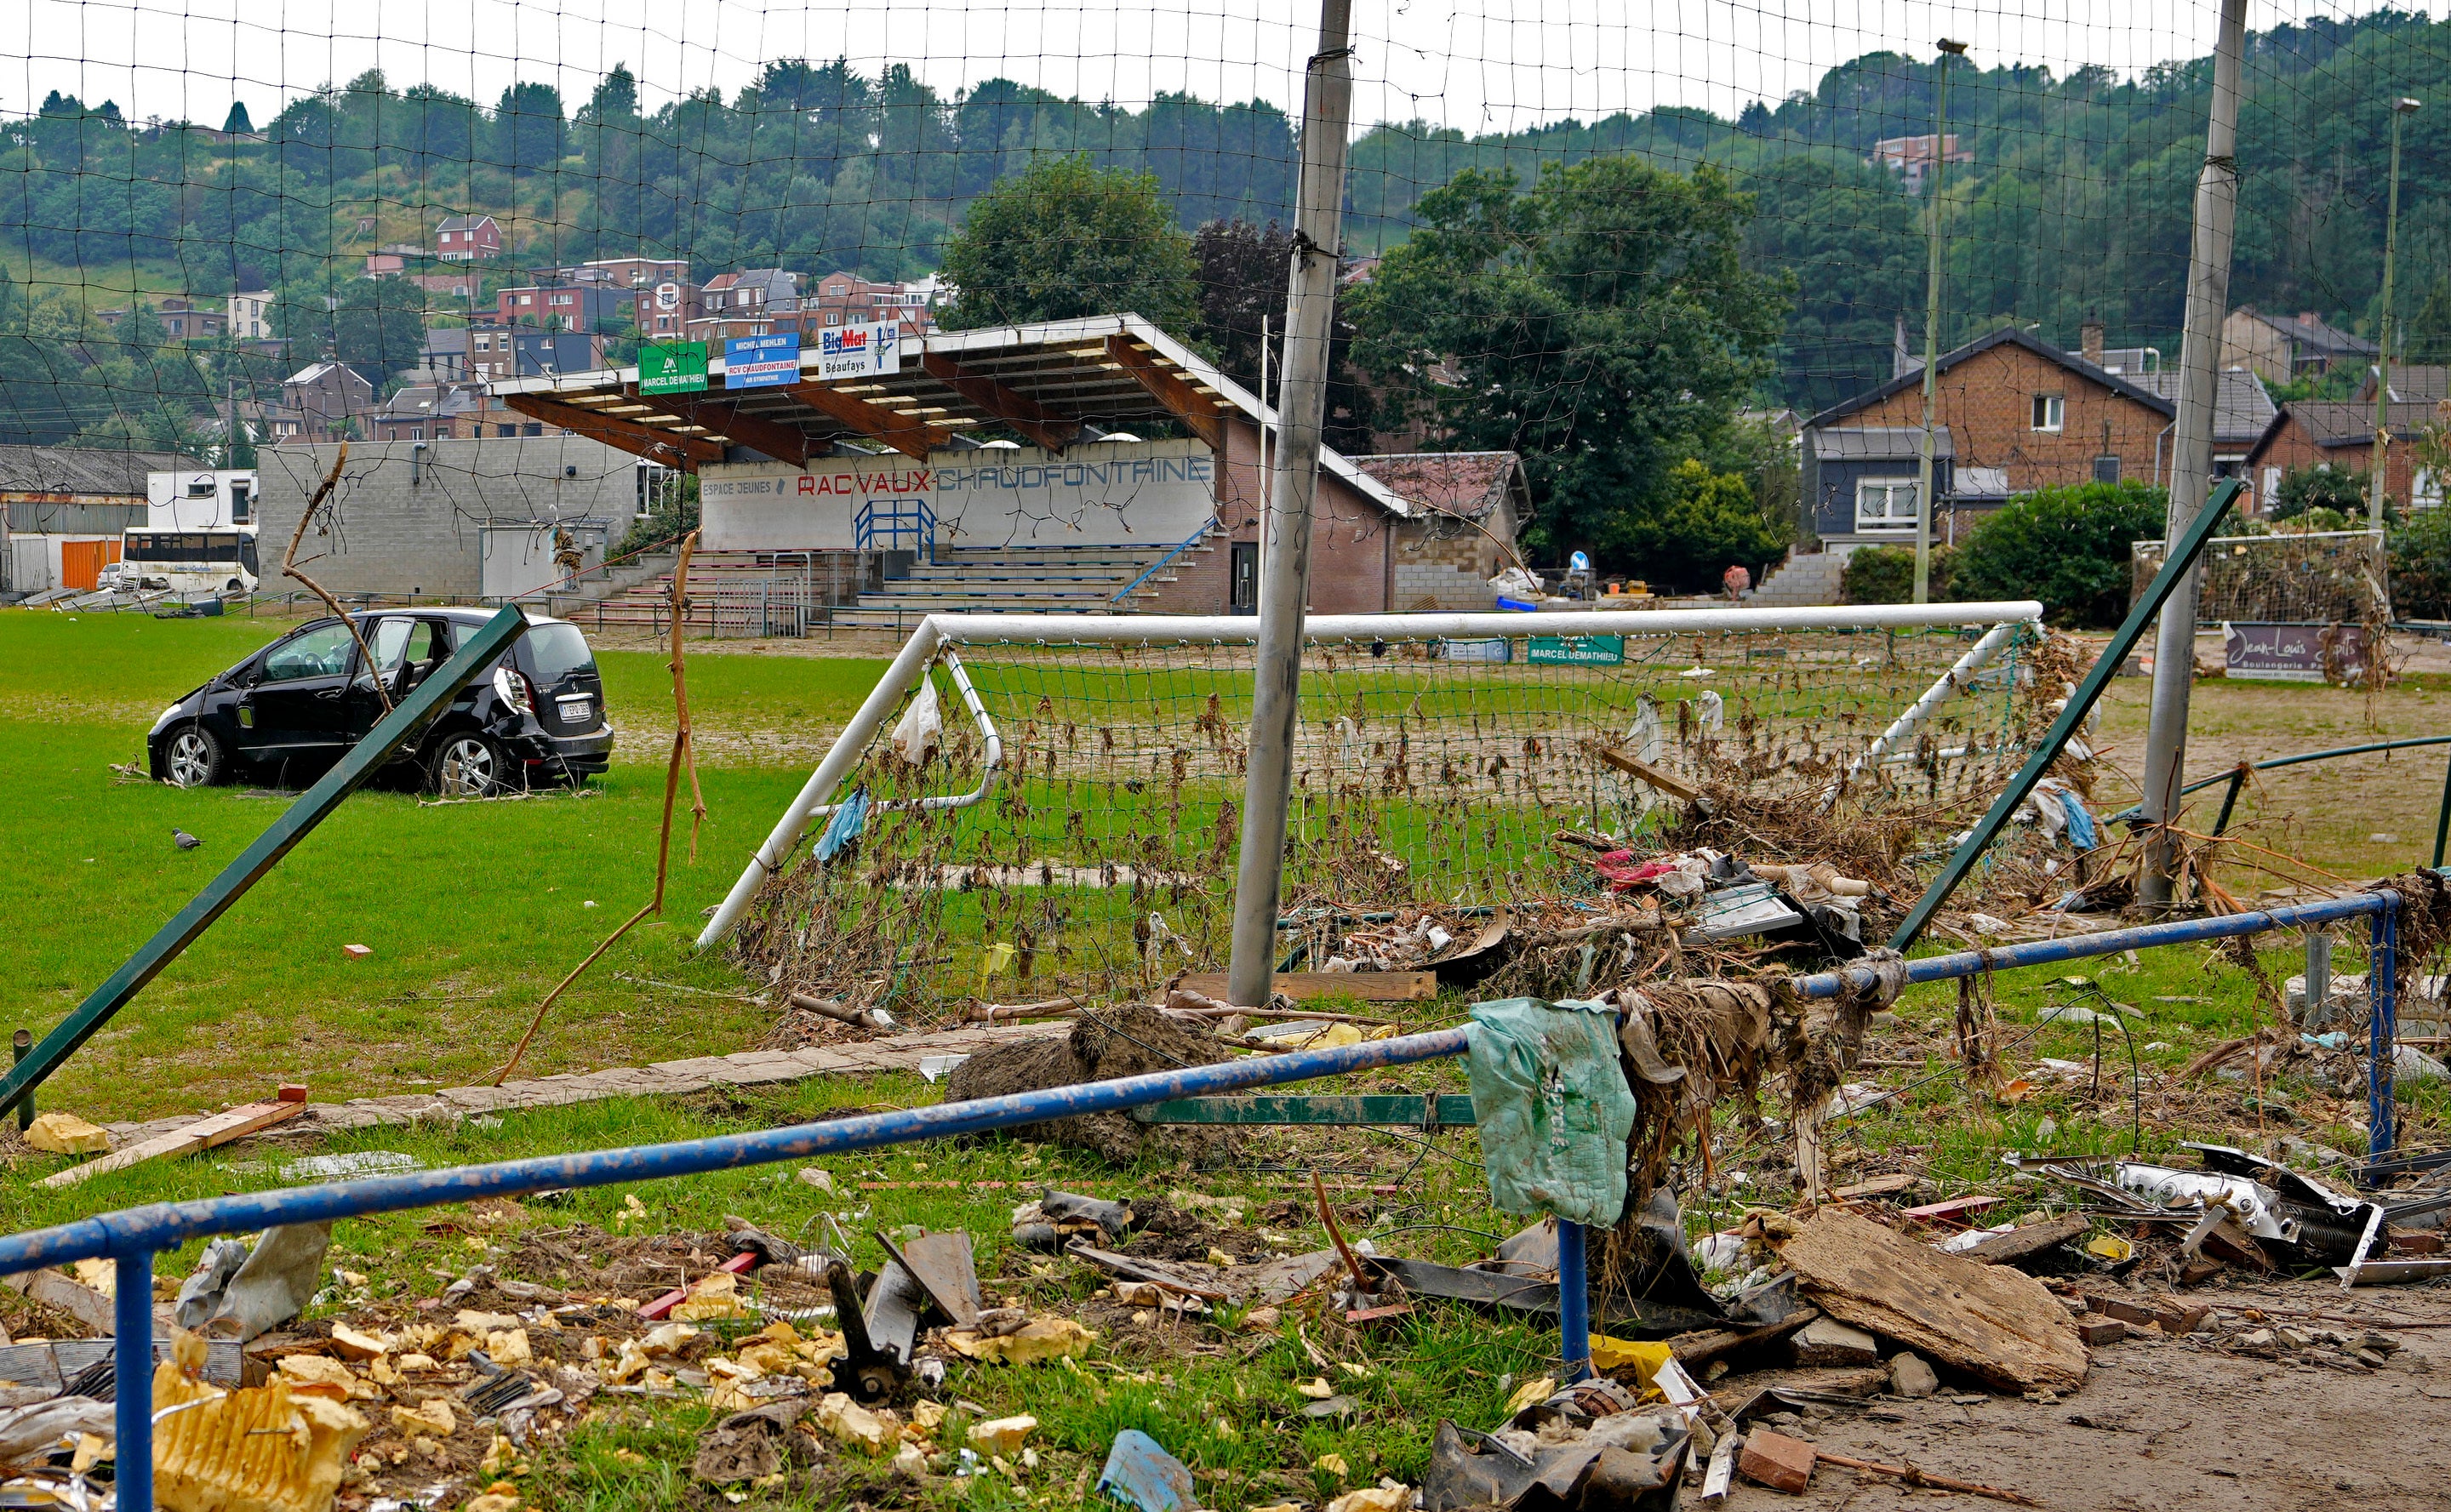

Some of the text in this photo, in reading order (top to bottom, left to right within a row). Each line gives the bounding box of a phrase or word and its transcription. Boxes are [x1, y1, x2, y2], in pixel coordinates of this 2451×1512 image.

[735, 338, 786, 351] MICHEL MEHLEN
[823, 329, 868, 354] BigMat
[742, 361, 795, 373] CHAUDFONTAINE
[826, 360, 866, 373] Beaufays
[642, 374, 705, 387] MARCEL DEMATHIEU
[703, 481, 771, 496] ESPACE JEUNES
[2228, 626, 2306, 665] Jean-Louis
[1531, 648, 1618, 661] MARCEL DEMATHIEU
[2242, 660, 2303, 670] Boulangerie
